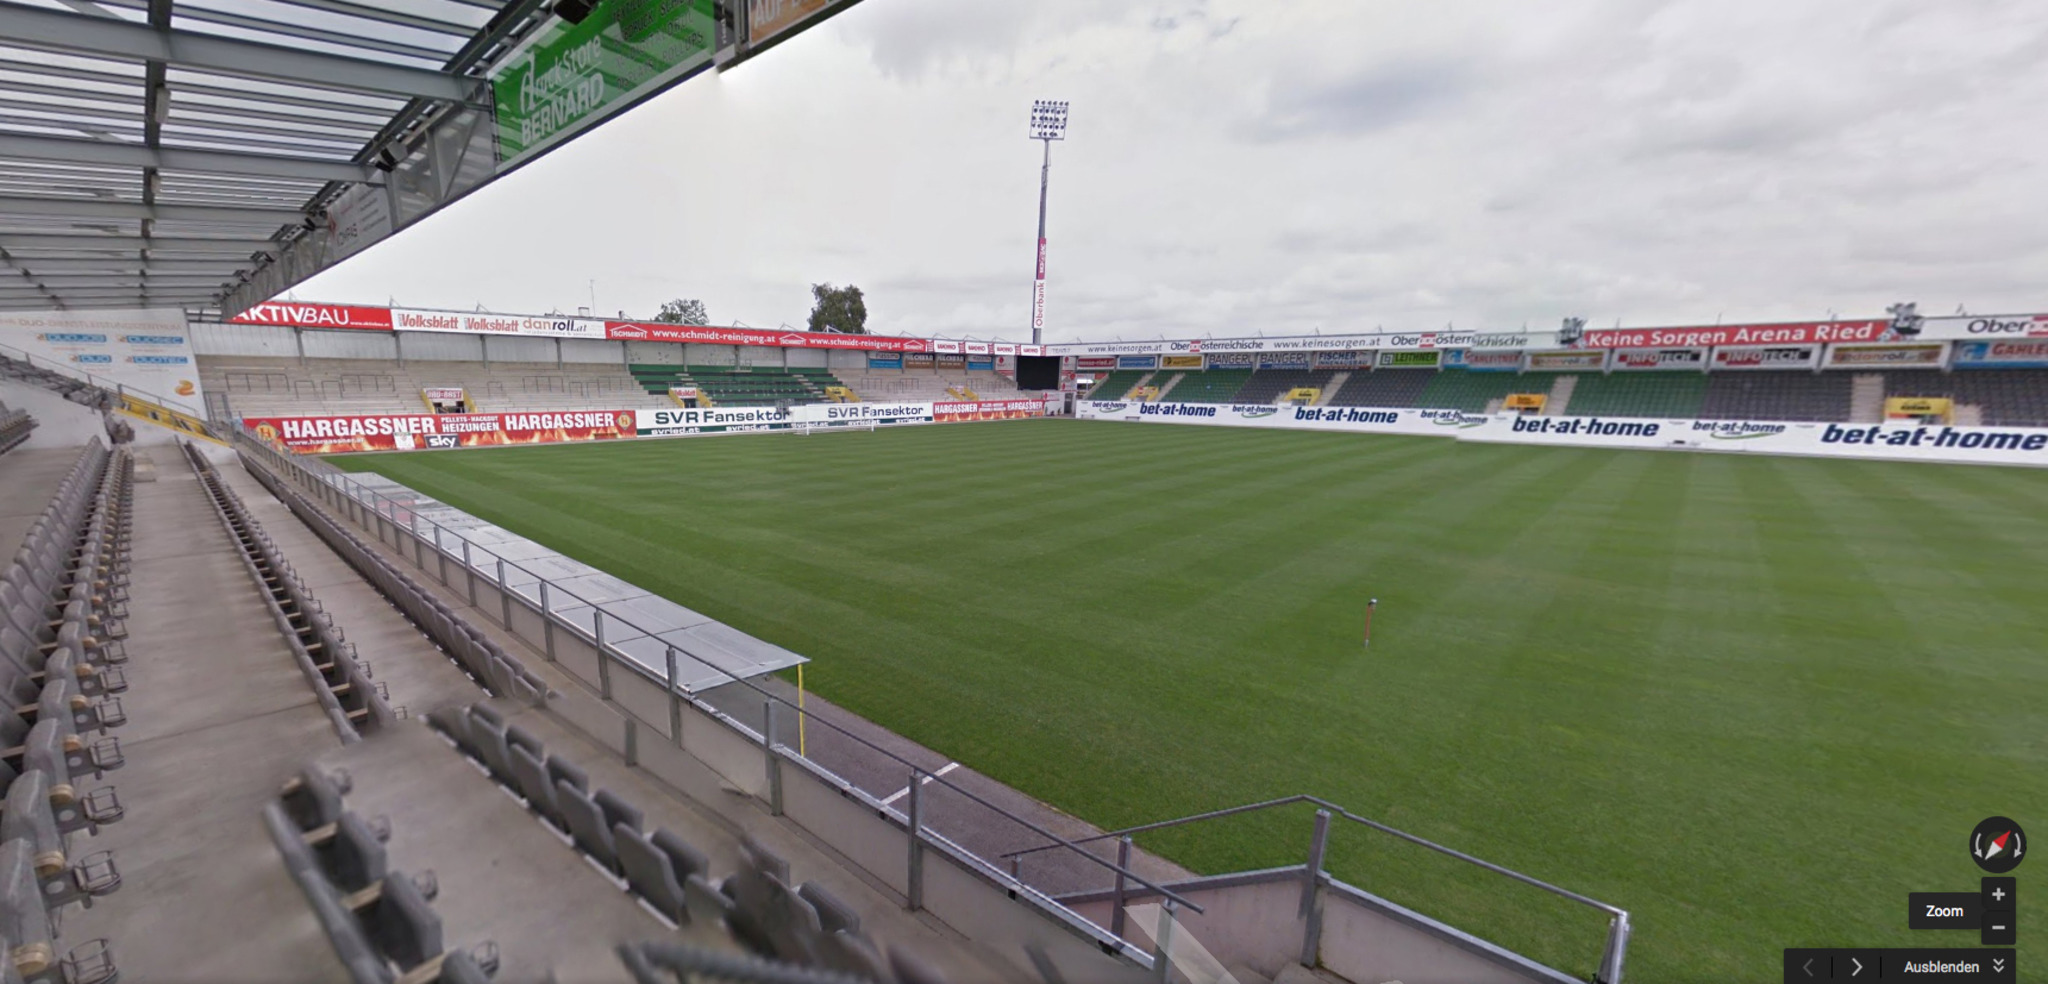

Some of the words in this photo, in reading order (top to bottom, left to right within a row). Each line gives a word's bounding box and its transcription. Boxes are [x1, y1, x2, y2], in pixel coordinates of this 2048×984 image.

[522, 72, 604, 146] BERNARD
[1035, 282, 1045, 327] Oberbank
[400, 313, 459, 330] Volksblatt
[466, 317, 519, 332] Volksblatt
[1967, 319, 2030, 334] Ober
[652, 329, 776, 344] www.schmidt-reinigung.at
[809, 337, 901, 349] www.schmidt-reinigung.at
[1391, 335, 1419, 346] Ober
[1589, 332, 1645, 347] Keine
[1651, 330, 1726, 347] Sorgen
[1733, 325, 1806, 342] Arena
[1814, 323, 1873, 340] Ried
[1087, 344, 1162, 354] www.keinesorgen.at
[1170, 341, 1190, 351] Ober
[1319, 352, 1357, 360] FISCHER
[828, 406, 859, 418] SVR
[862, 405, 924, 417] Fansektor
[934, 403, 978, 414] HARGASSNER
[505, 413, 614, 430] HARGASSNER
[655, 411, 699, 424] SVR
[703, 409, 790, 423] Fansektor
[282, 417, 435, 438] HARGASSNER
[442, 422, 499, 433] HEIZUNGEN
[651, 426, 700, 435] svried.at
[725, 424, 770, 432] svried.at
[1139, 402, 1216, 417] bet-at-home
[1295, 406, 1398, 424] bet-at-home
[1512, 416, 1660, 437] bet-at-home
[1692, 420, 1786, 433] bet-at-home
[1821, 423, 2047, 450] bet-at-home
[429, 435, 456, 448] sky
